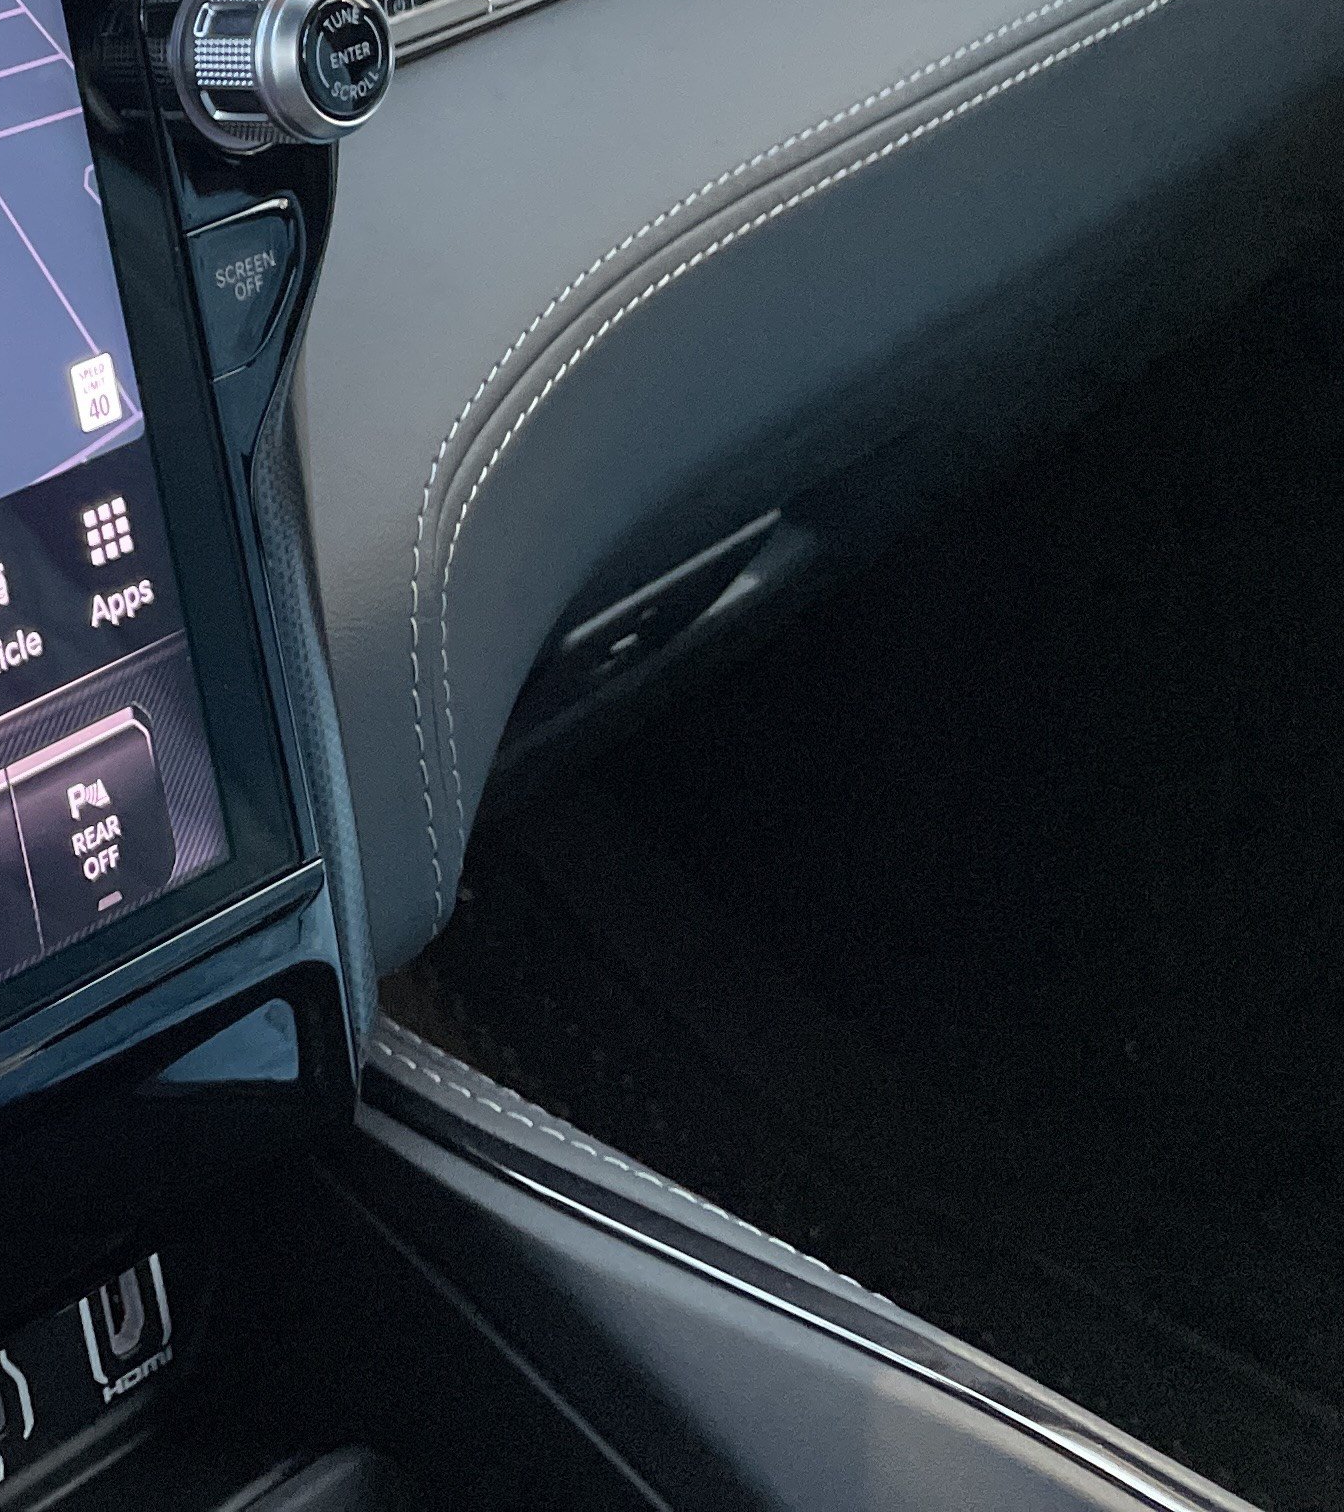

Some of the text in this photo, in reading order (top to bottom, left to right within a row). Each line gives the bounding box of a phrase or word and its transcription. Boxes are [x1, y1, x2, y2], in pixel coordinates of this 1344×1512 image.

[322, 7, 361, 35] TUNE
[330, 41, 372, 70] ENTER
[330, 70, 381, 102] SCROLL
[215, 249, 276, 288] SCREEN
[234, 272, 264, 302] OFF
[89, 393, 110, 419] 40
[90, 579, 154, 628] Apps
[71, 815, 121, 857] REAR
[81, 843, 121, 881] OFF
[103, 1345, 172, 1404] HDMI
